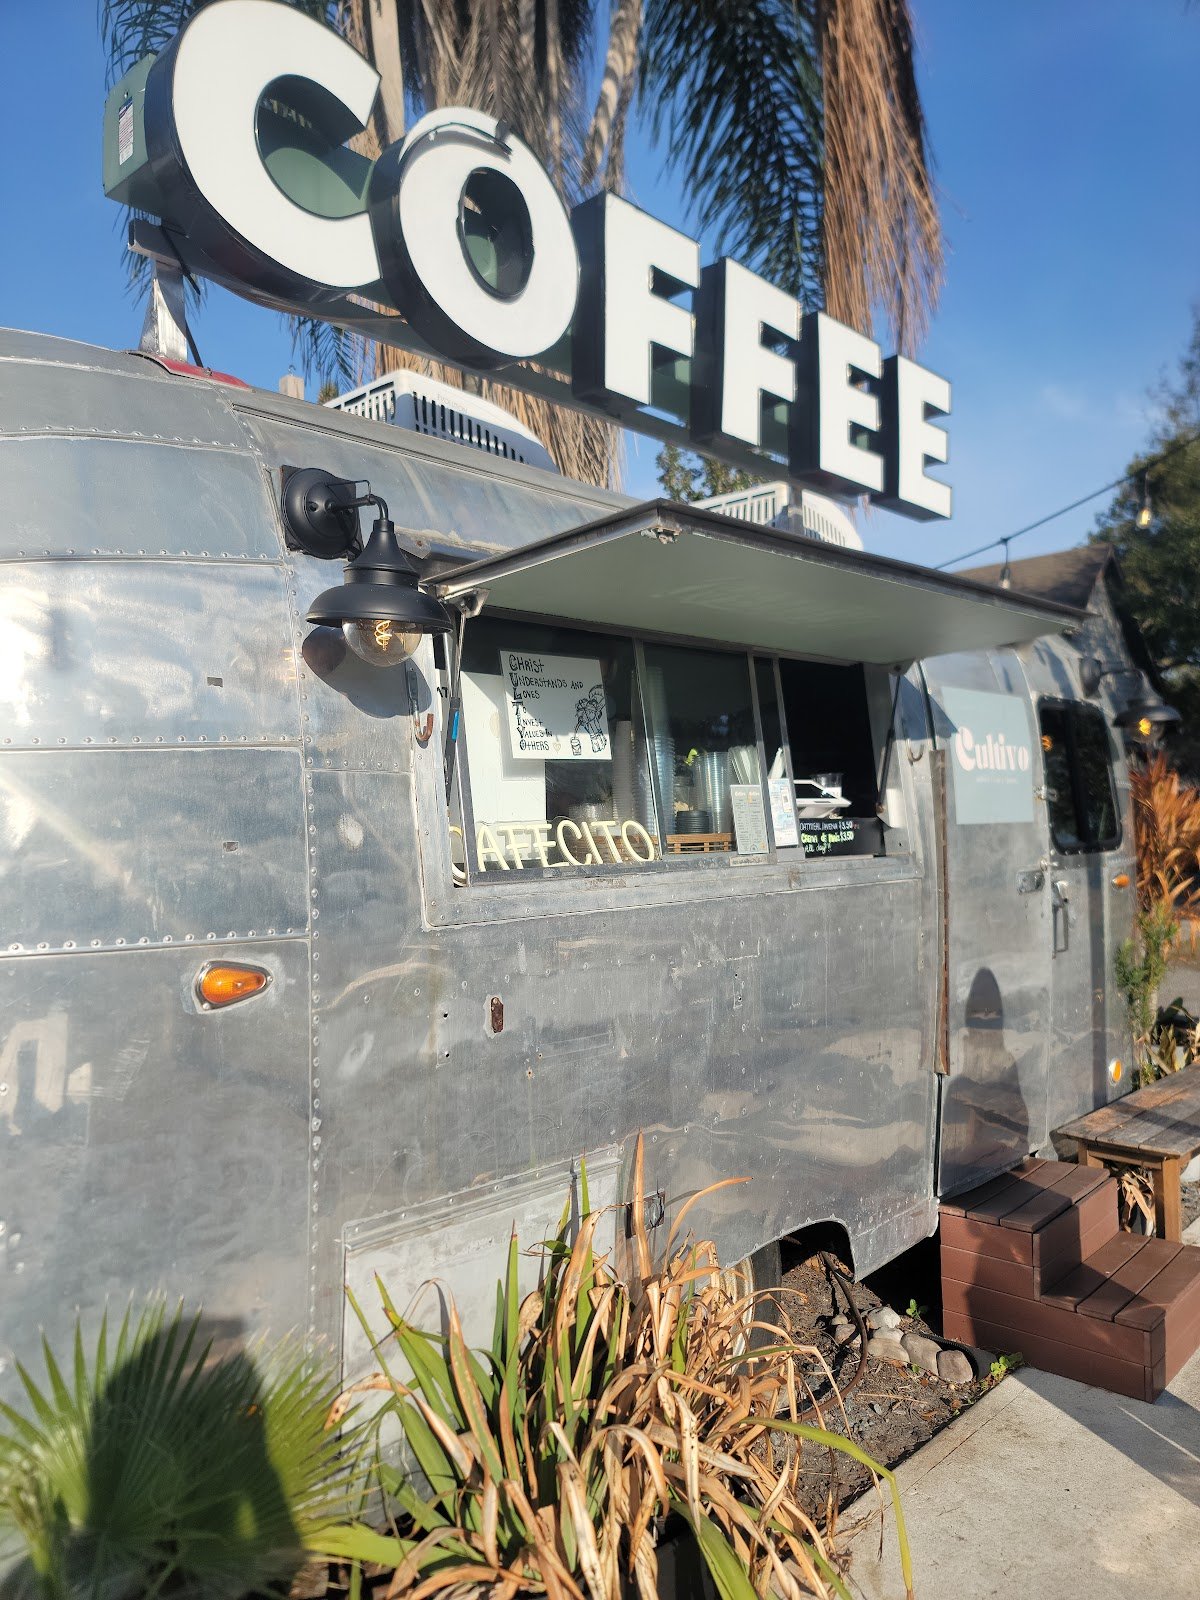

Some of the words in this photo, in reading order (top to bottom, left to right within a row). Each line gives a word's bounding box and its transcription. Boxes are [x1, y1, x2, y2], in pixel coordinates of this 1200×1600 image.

[171, 0, 952, 520] COFFEE
[571, 681, 584, 690] AND
[513, 687, 540, 700] LOVES
[516, 726, 545, 739] VALUES
[954, 726, 1030, 771] Cultivo
